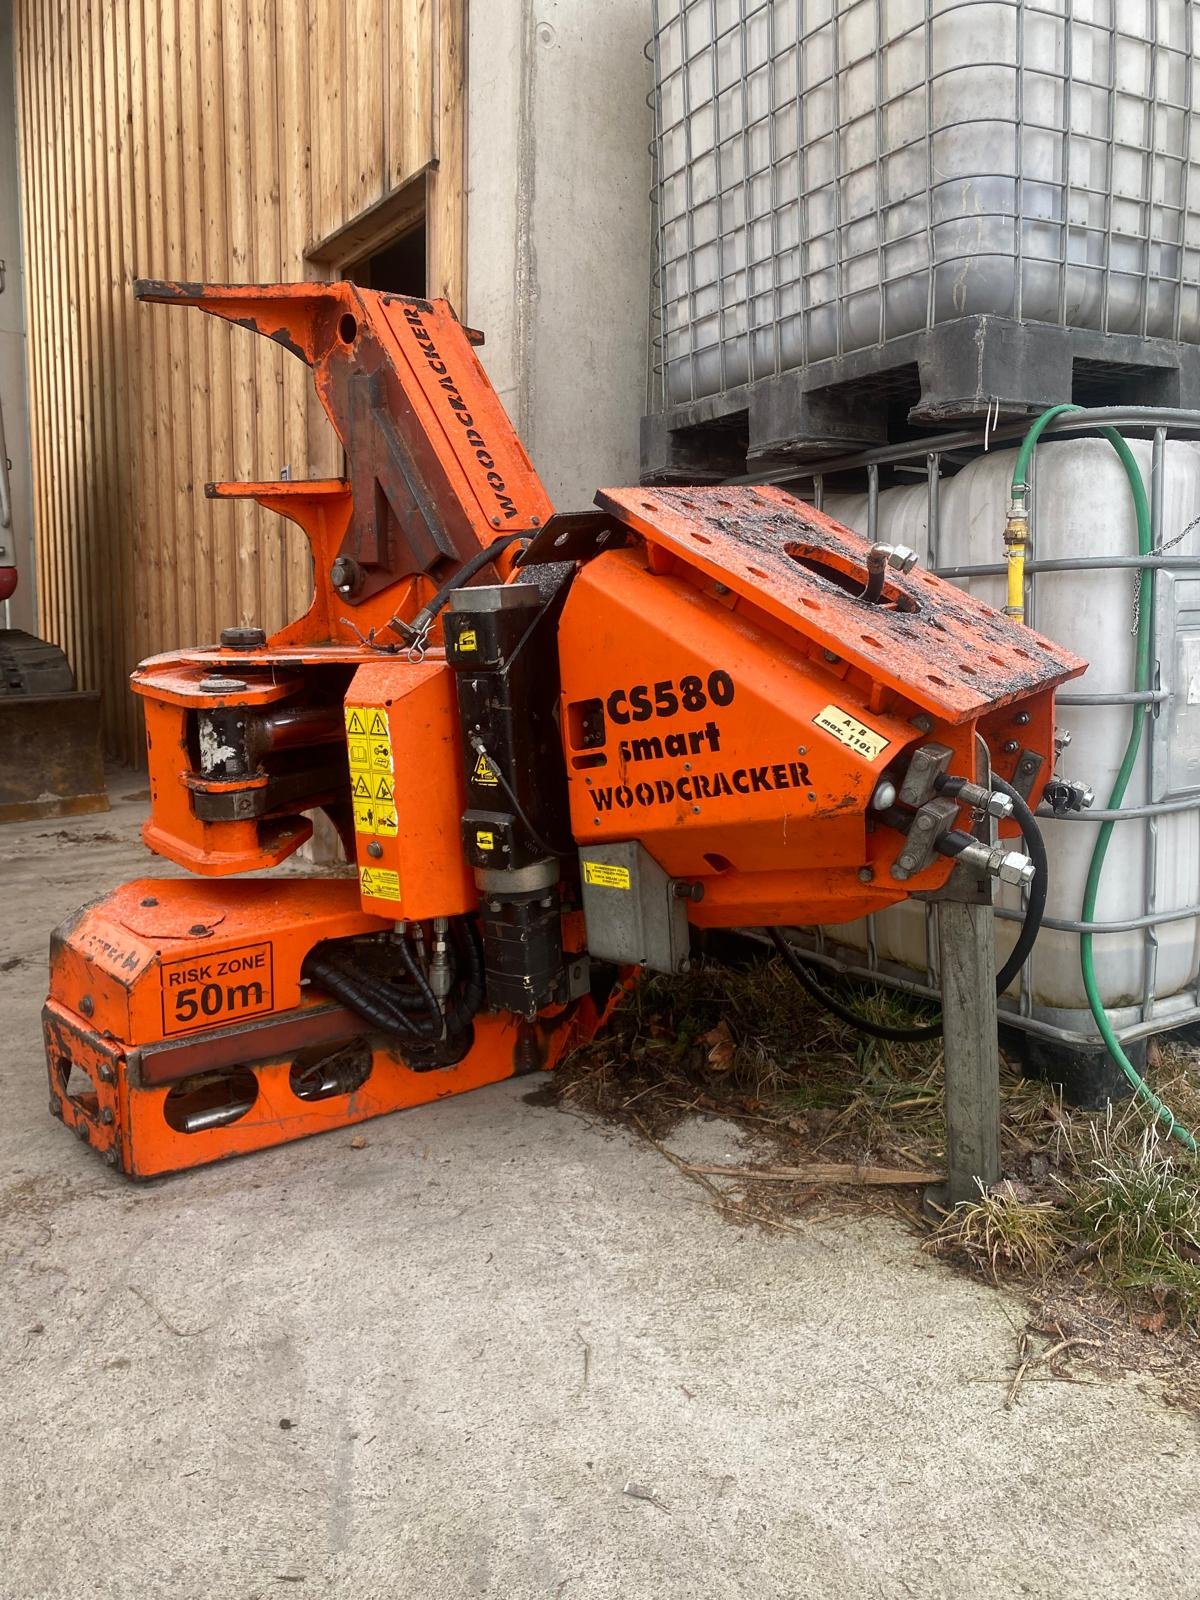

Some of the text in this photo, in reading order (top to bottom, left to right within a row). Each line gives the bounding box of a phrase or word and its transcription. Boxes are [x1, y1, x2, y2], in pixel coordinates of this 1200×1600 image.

[403, 305, 518, 519] WOODCRACKER
[607, 670, 735, 725] CS580
[620, 721, 720, 762] smart
[821, 719, 871, 753] max. 110L
[590, 762, 812, 811] WOODCRACKER
[169, 954, 265, 986] RISK ZONE
[176, 982, 263, 1022] 50m
